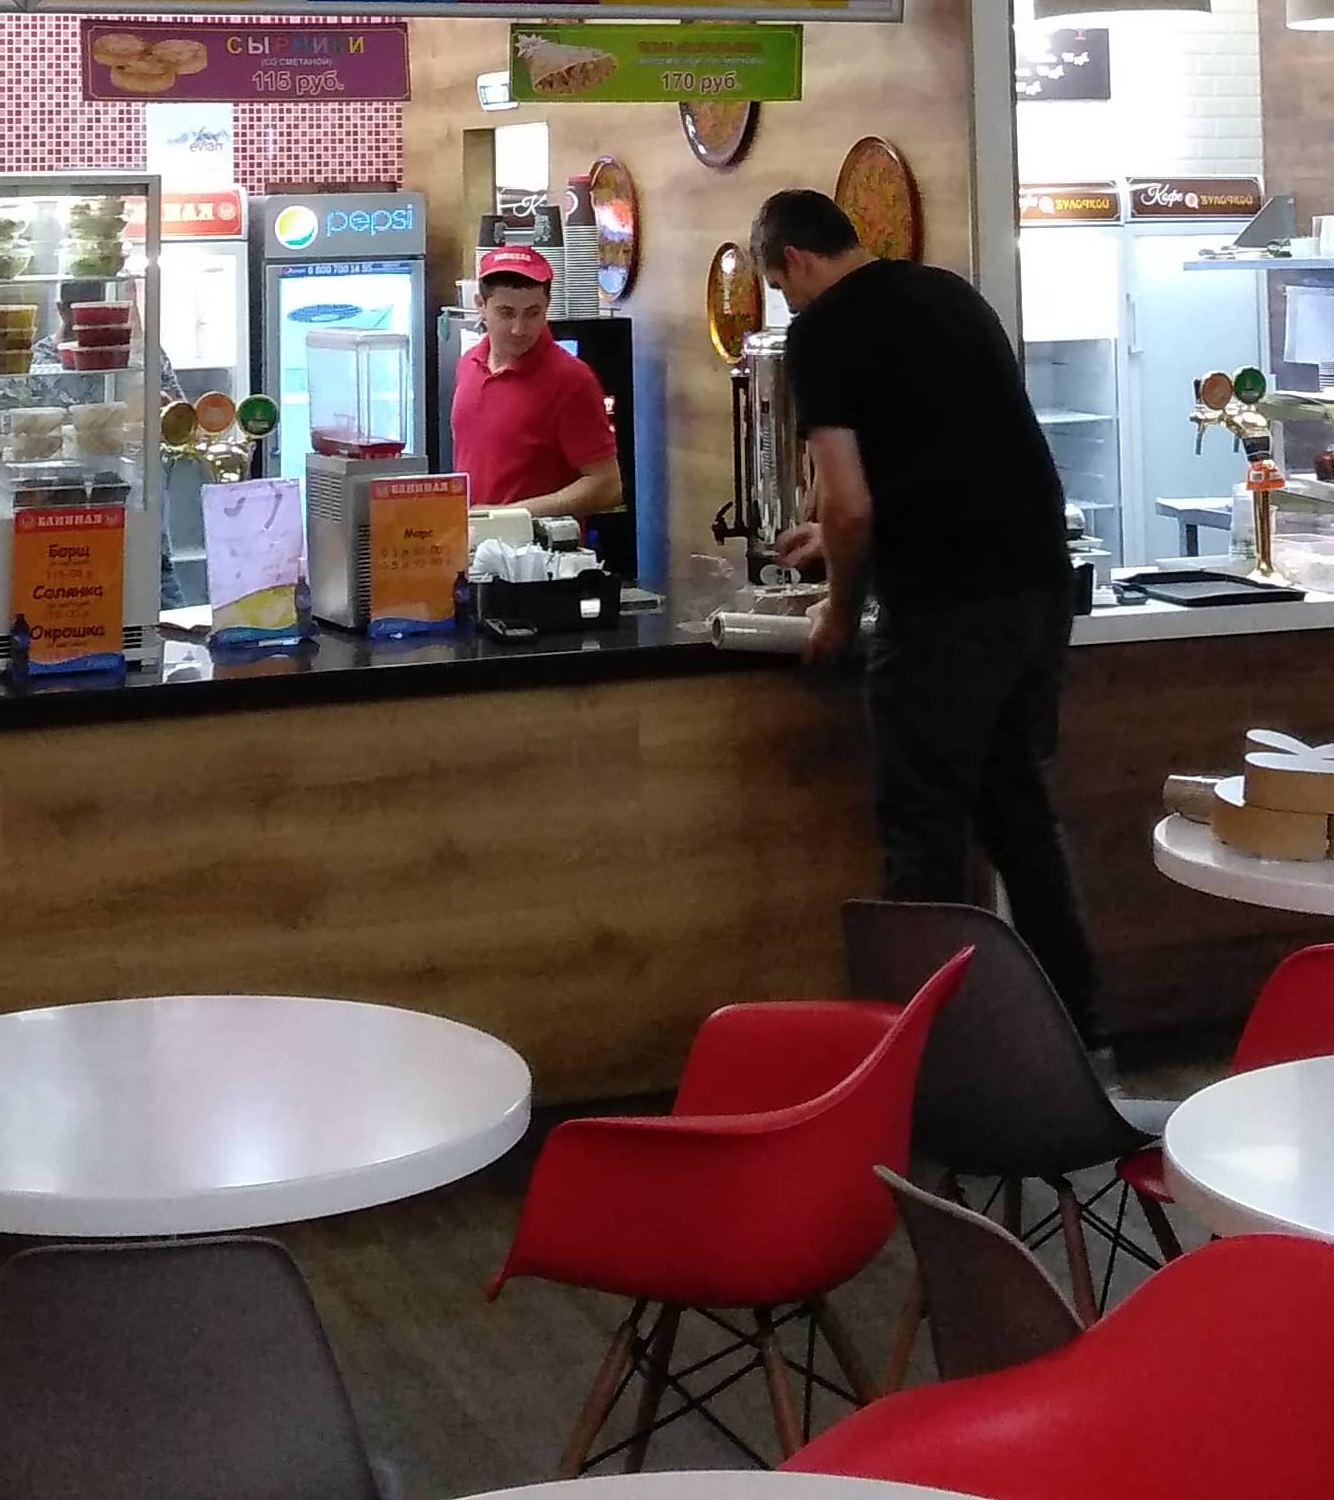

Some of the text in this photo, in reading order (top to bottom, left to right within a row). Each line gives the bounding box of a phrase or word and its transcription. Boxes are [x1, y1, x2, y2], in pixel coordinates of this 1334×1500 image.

[251, 69, 345, 96] 115 руб.
[661, 70, 696, 91] 170
[1139, 182, 1184, 208] Кафе
[326, 203, 413, 237] pepsi
[48, 544, 90, 561] Борщ
[32, 584, 104, 600] Солянка
[30, 624, 105, 643] Окрошка
